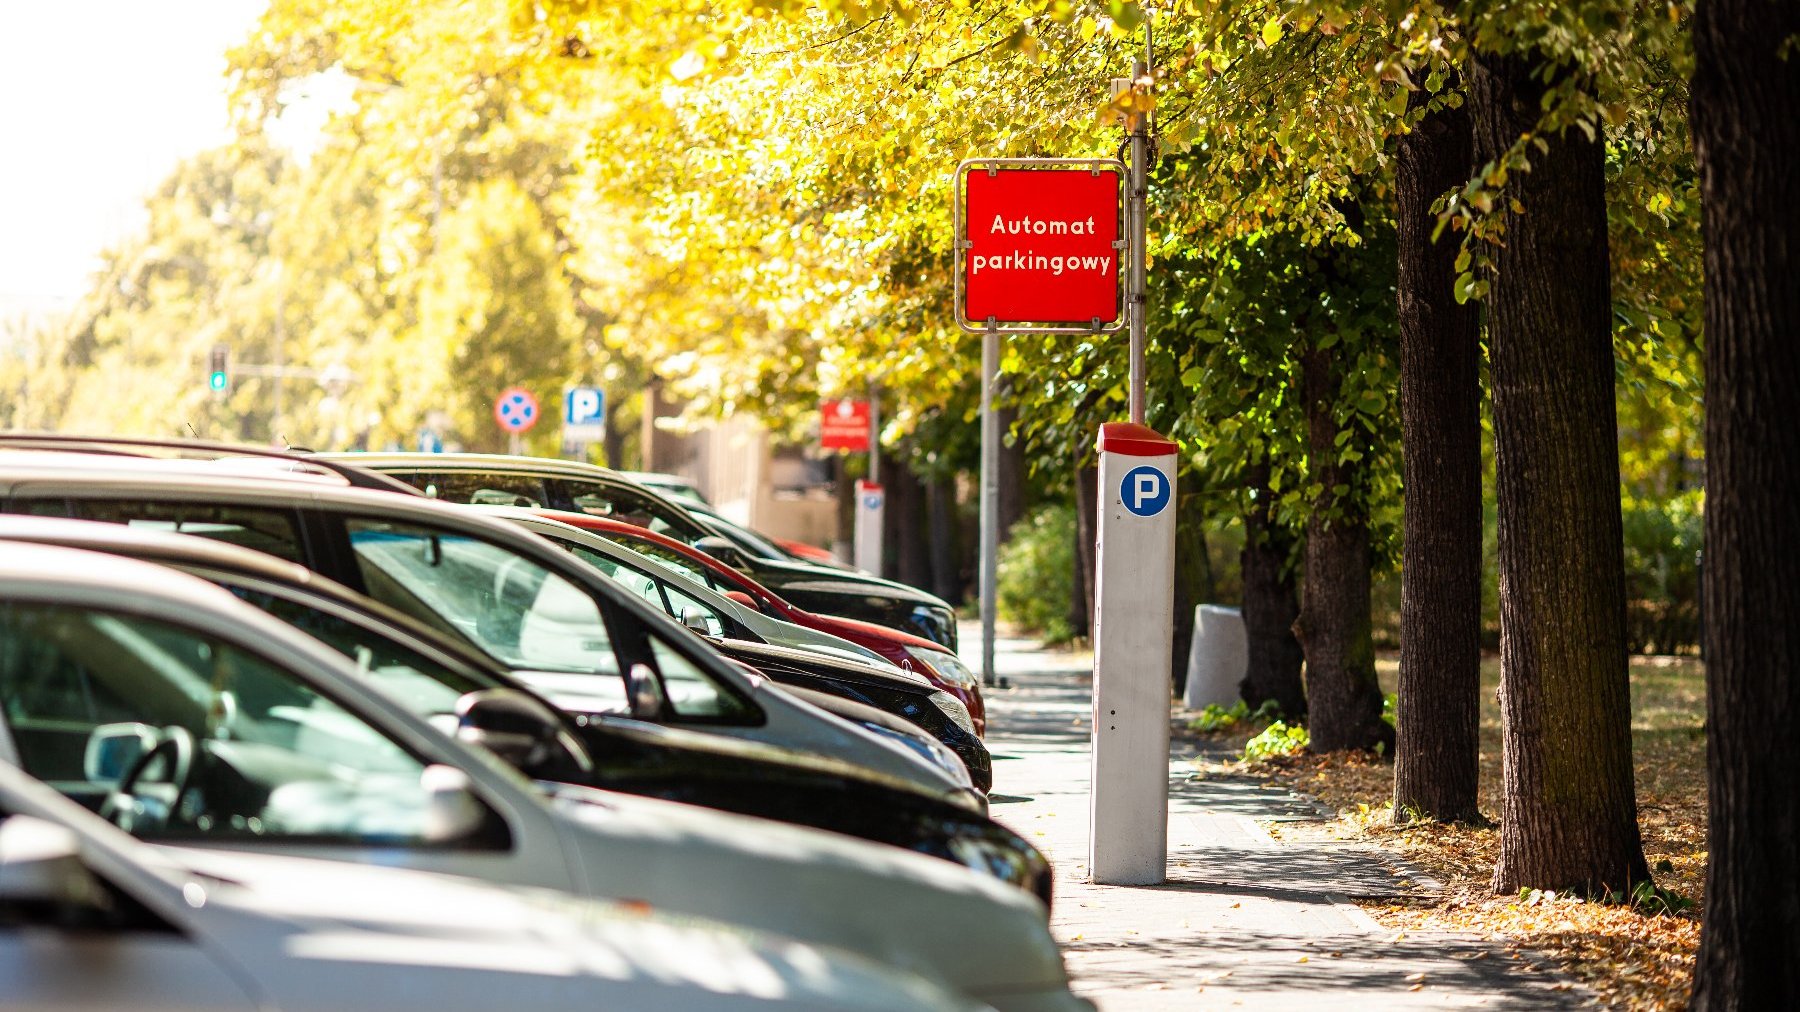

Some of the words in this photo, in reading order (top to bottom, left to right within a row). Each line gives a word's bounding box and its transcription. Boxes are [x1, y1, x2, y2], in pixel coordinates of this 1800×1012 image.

[990, 214, 1095, 235] Automat
[972, 250, 1111, 276] parkingowy
[573, 389, 599, 421] P
[1134, 474, 1160, 509] P
